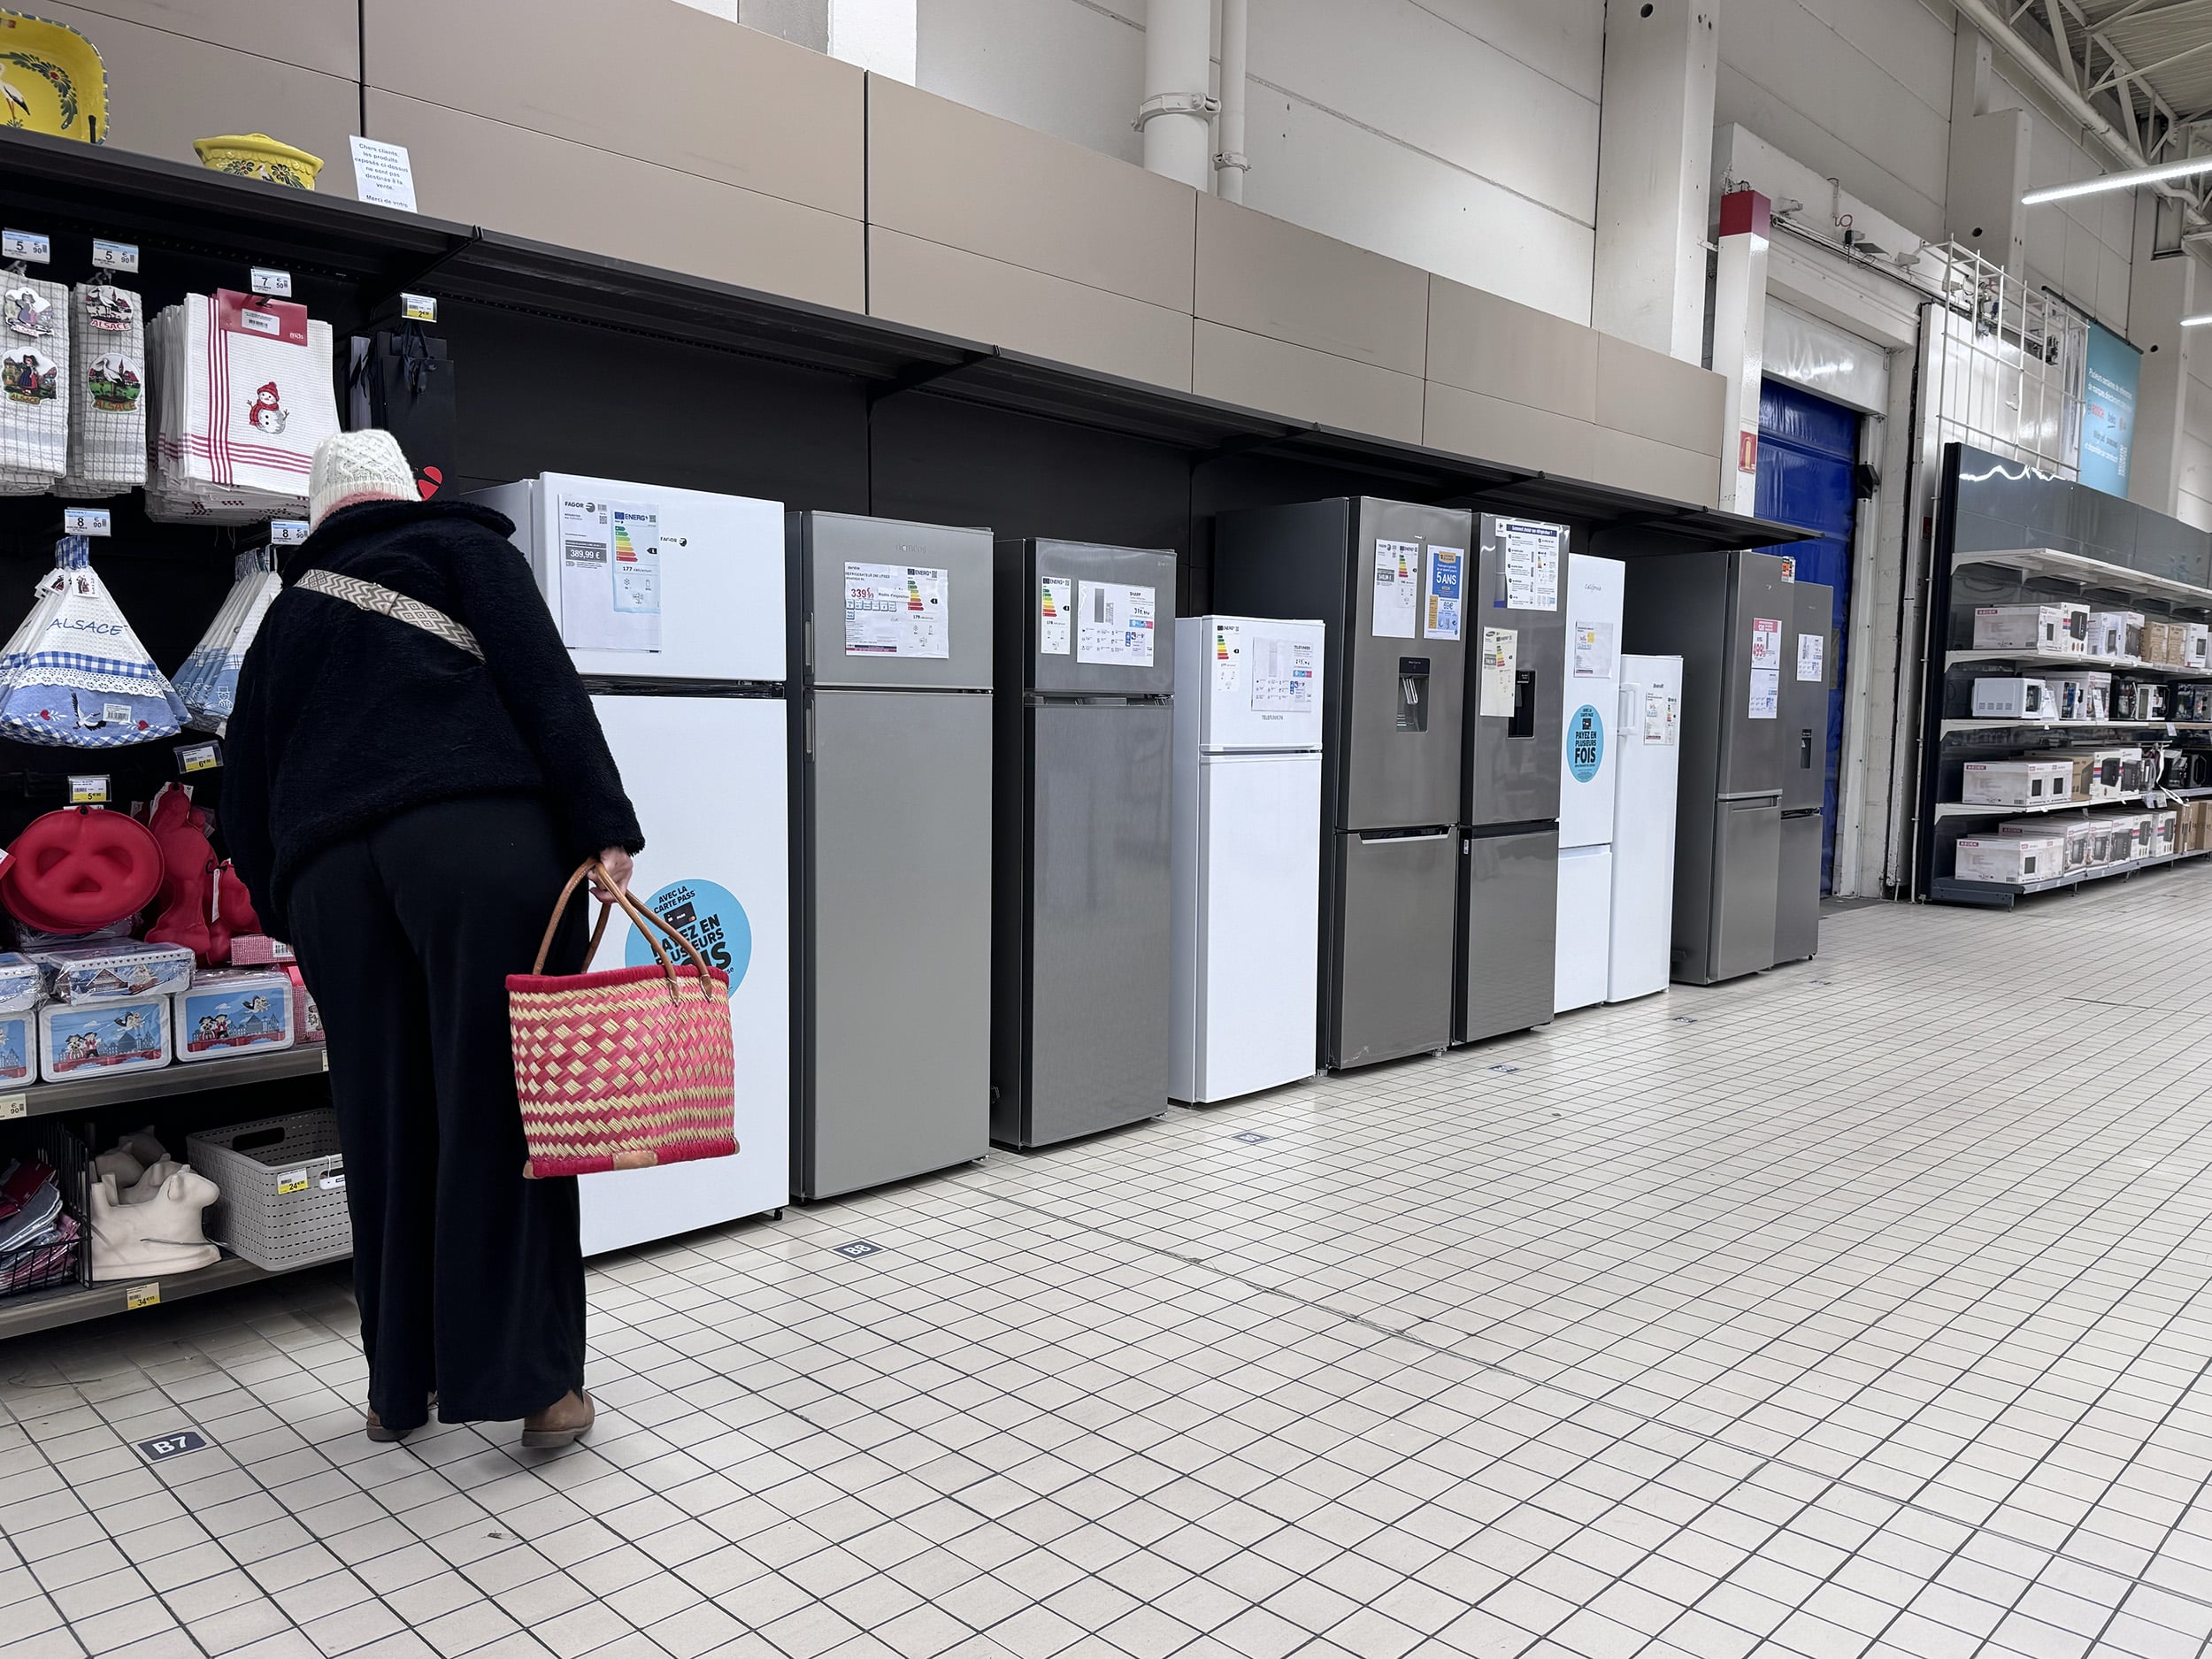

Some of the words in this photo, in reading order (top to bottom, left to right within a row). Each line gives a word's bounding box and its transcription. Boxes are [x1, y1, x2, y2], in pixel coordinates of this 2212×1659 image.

[366, 194, 383, 203] Merci
[16, 241, 24, 251] 5
[105, 250, 113, 261] 5
[261, 277, 269, 287] 7
[91, 319, 130, 331] ALSACE
[94, 400, 137, 412] ALSACE
[77, 517, 84, 527] 8
[283, 529, 288, 538] 8
[570, 549, 594, 559] 389,99
[1436, 571, 1441, 583] 5
[1442, 574, 1457, 585] ANS
[851, 588, 866, 598] 339
[47, 617, 123, 636] ALSACE
[1575, 747, 1596, 763] FOIS
[654, 899, 677, 914] CARTE
[678, 891, 696, 902] PASS
[659, 891, 677, 903] AVEC
[699, 914, 721, 934] EN
[843, 1244, 871, 1255] B8
[152, 1436, 187, 1454] B7
